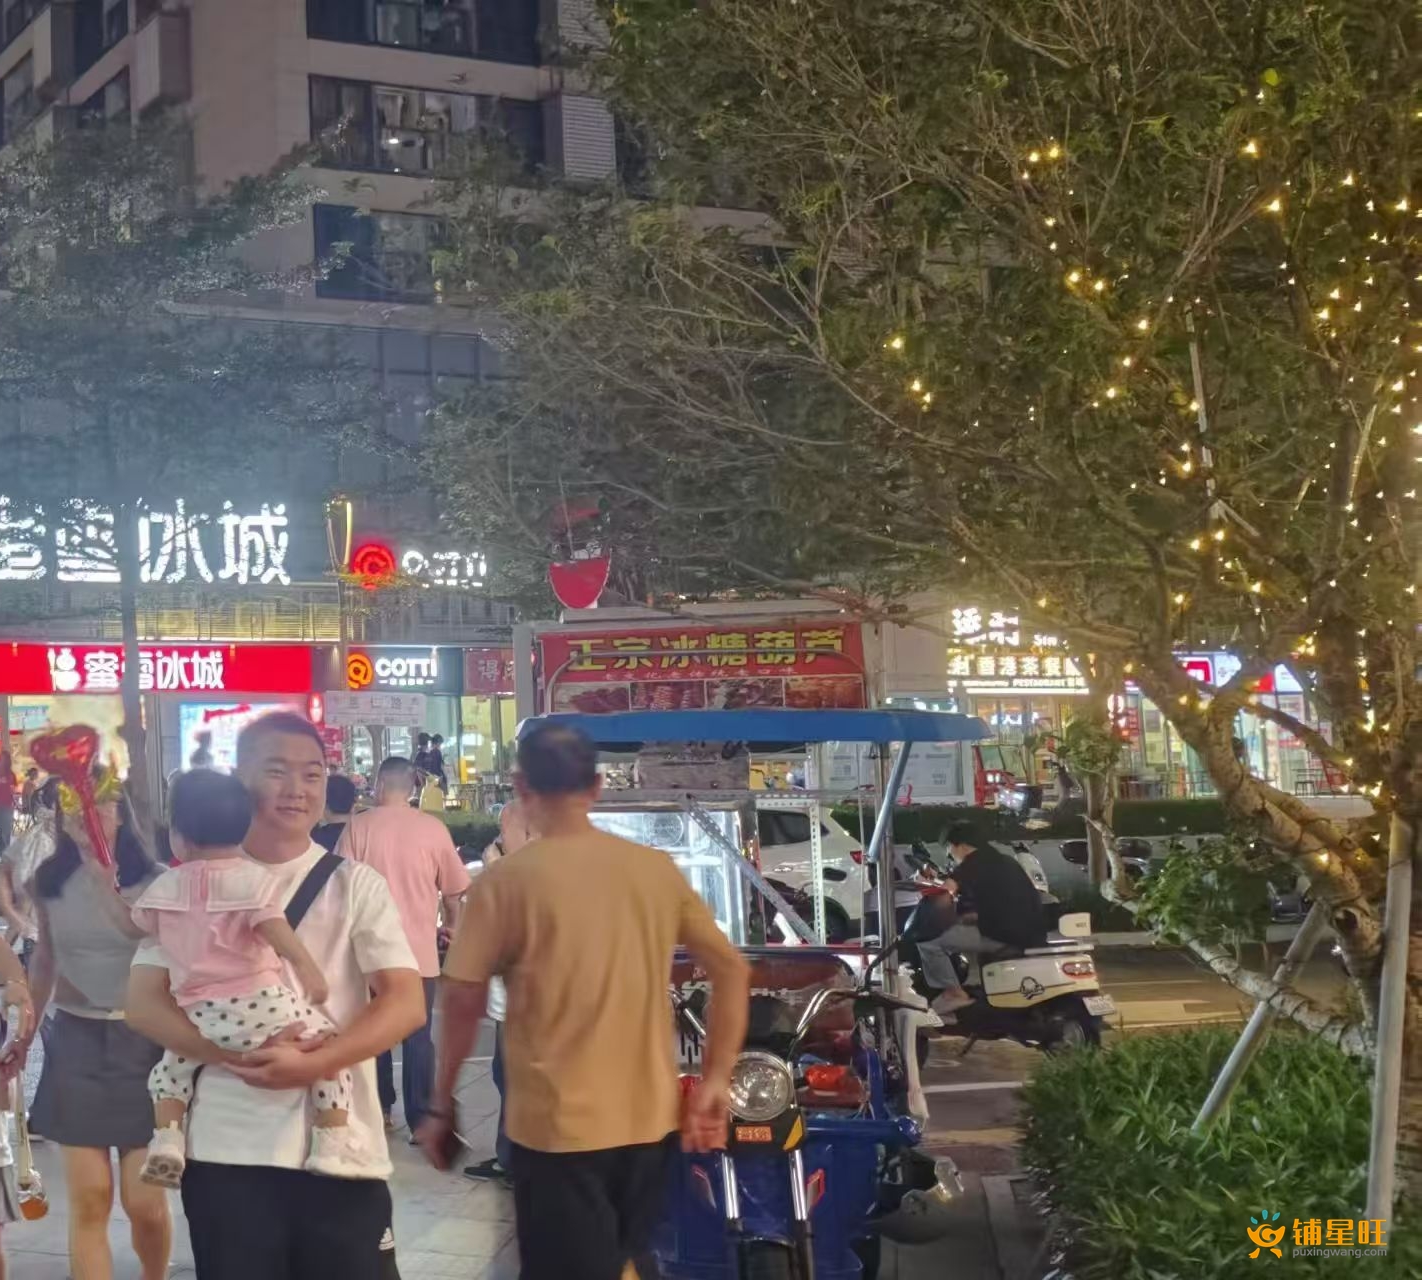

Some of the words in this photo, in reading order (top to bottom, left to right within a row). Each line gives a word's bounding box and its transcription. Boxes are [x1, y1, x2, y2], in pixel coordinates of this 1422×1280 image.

[565, 630, 844, 672] 正宗冰糖葫芦
[375, 657, 438, 677] COTTI
